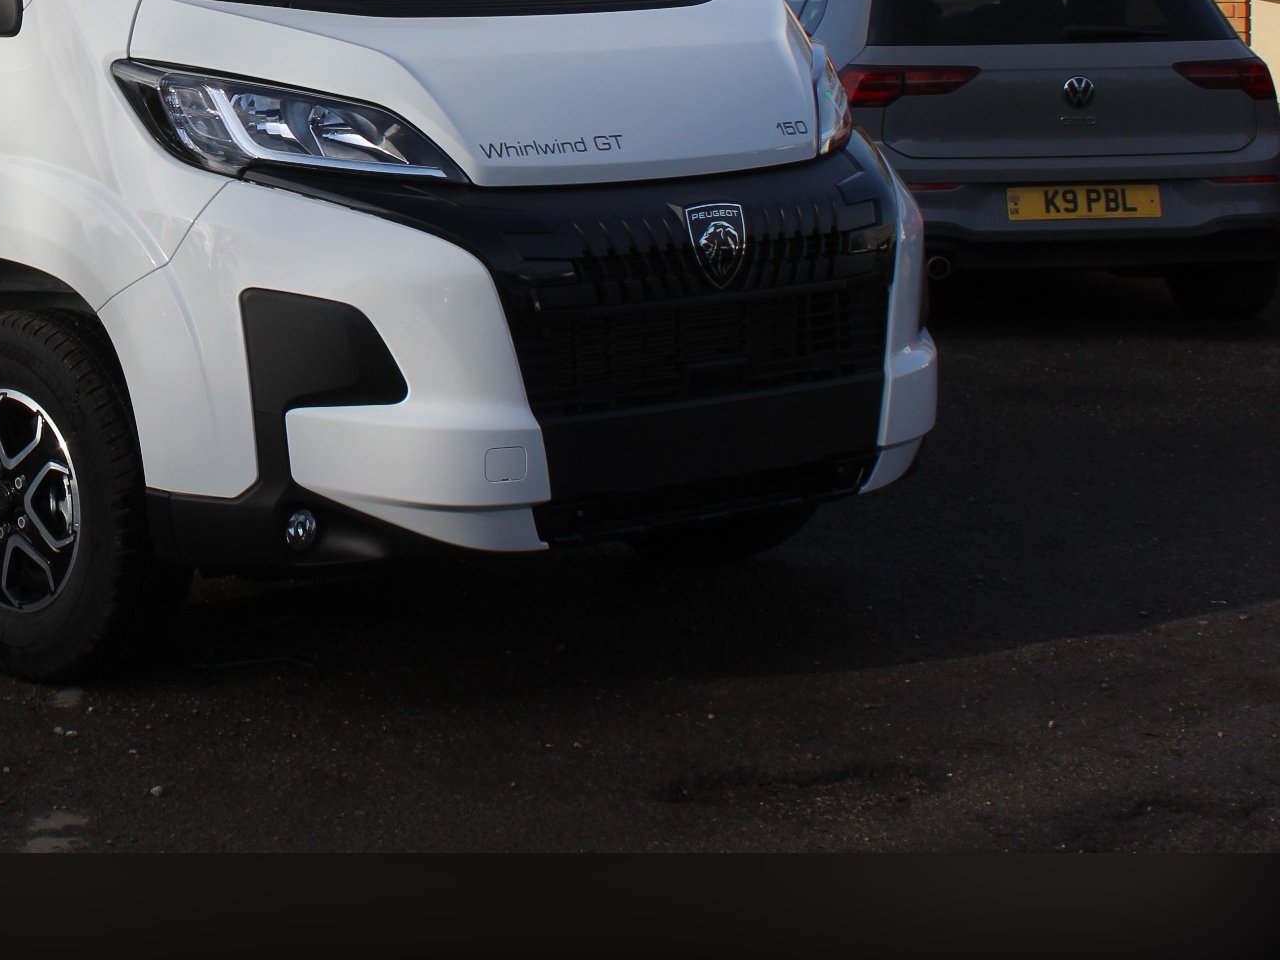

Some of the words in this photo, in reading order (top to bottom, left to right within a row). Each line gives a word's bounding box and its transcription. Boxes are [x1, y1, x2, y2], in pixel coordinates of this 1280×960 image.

[776, 120, 808, 136] 150
[479, 137, 587, 159] Whirlwind
[593, 134, 623, 152] GT
[1044, 189, 1078, 214] K9
[1086, 188, 1138, 213] PBL
[691, 209, 739, 221] PEUGEOT
[1010, 207, 1020, 215] UK
